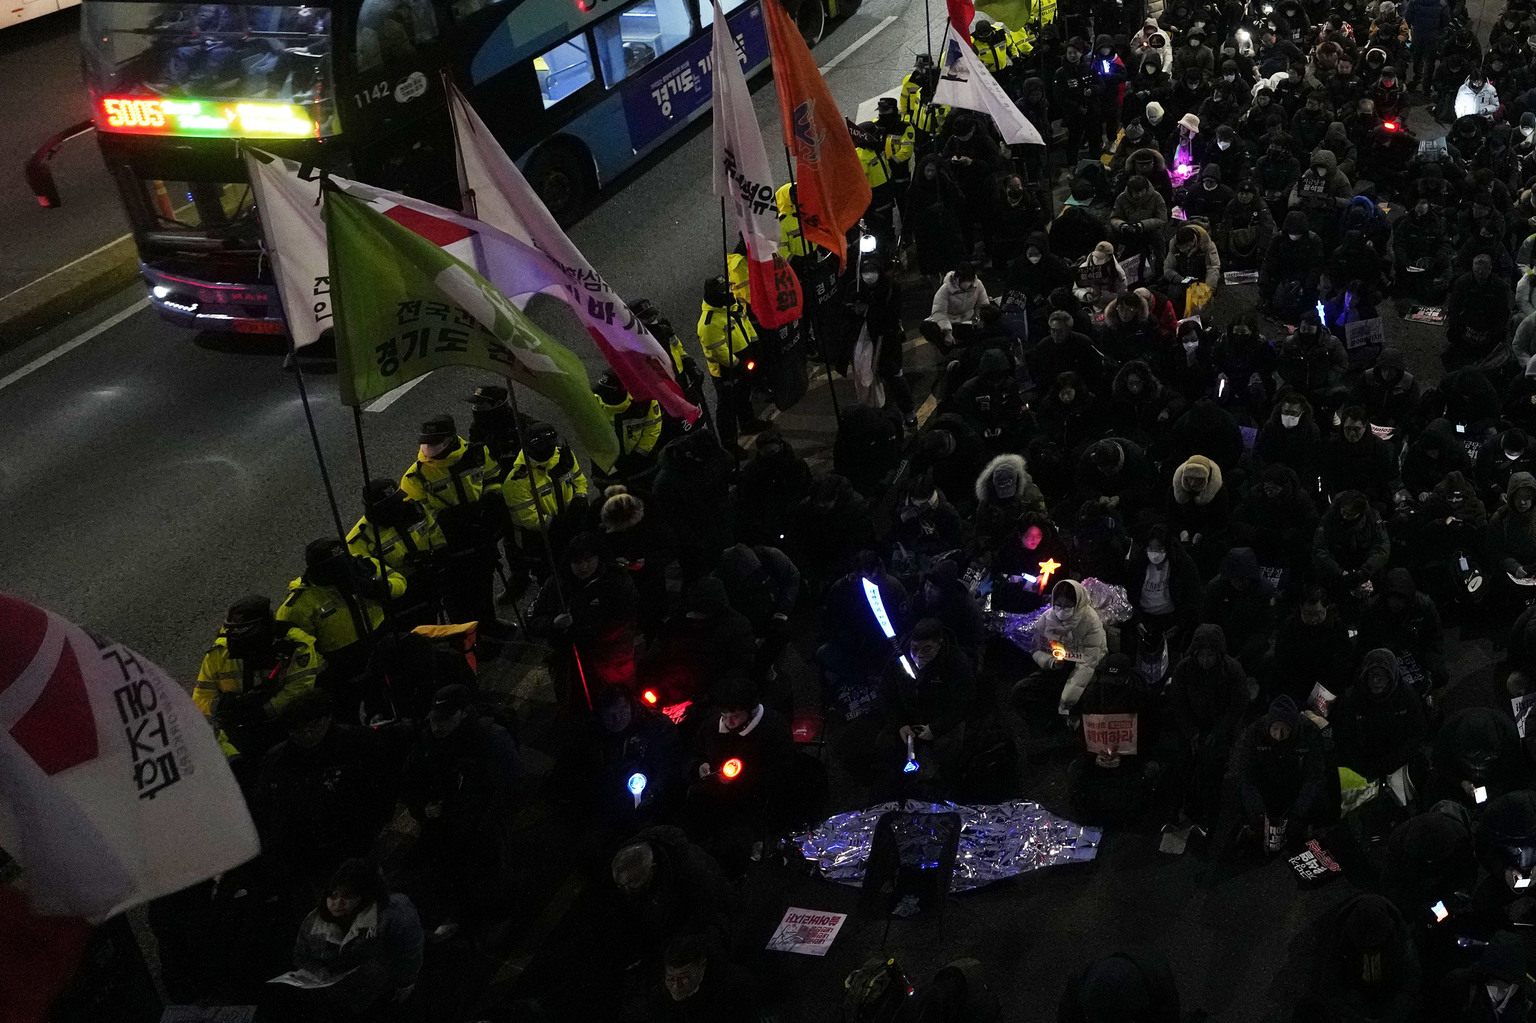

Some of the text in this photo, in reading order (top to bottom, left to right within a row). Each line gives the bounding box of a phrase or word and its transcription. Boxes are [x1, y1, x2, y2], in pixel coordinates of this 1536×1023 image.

[353, 80, 390, 109] 1142
[103, 98, 165, 127] 5005
[375, 326, 470, 377] 경기도
